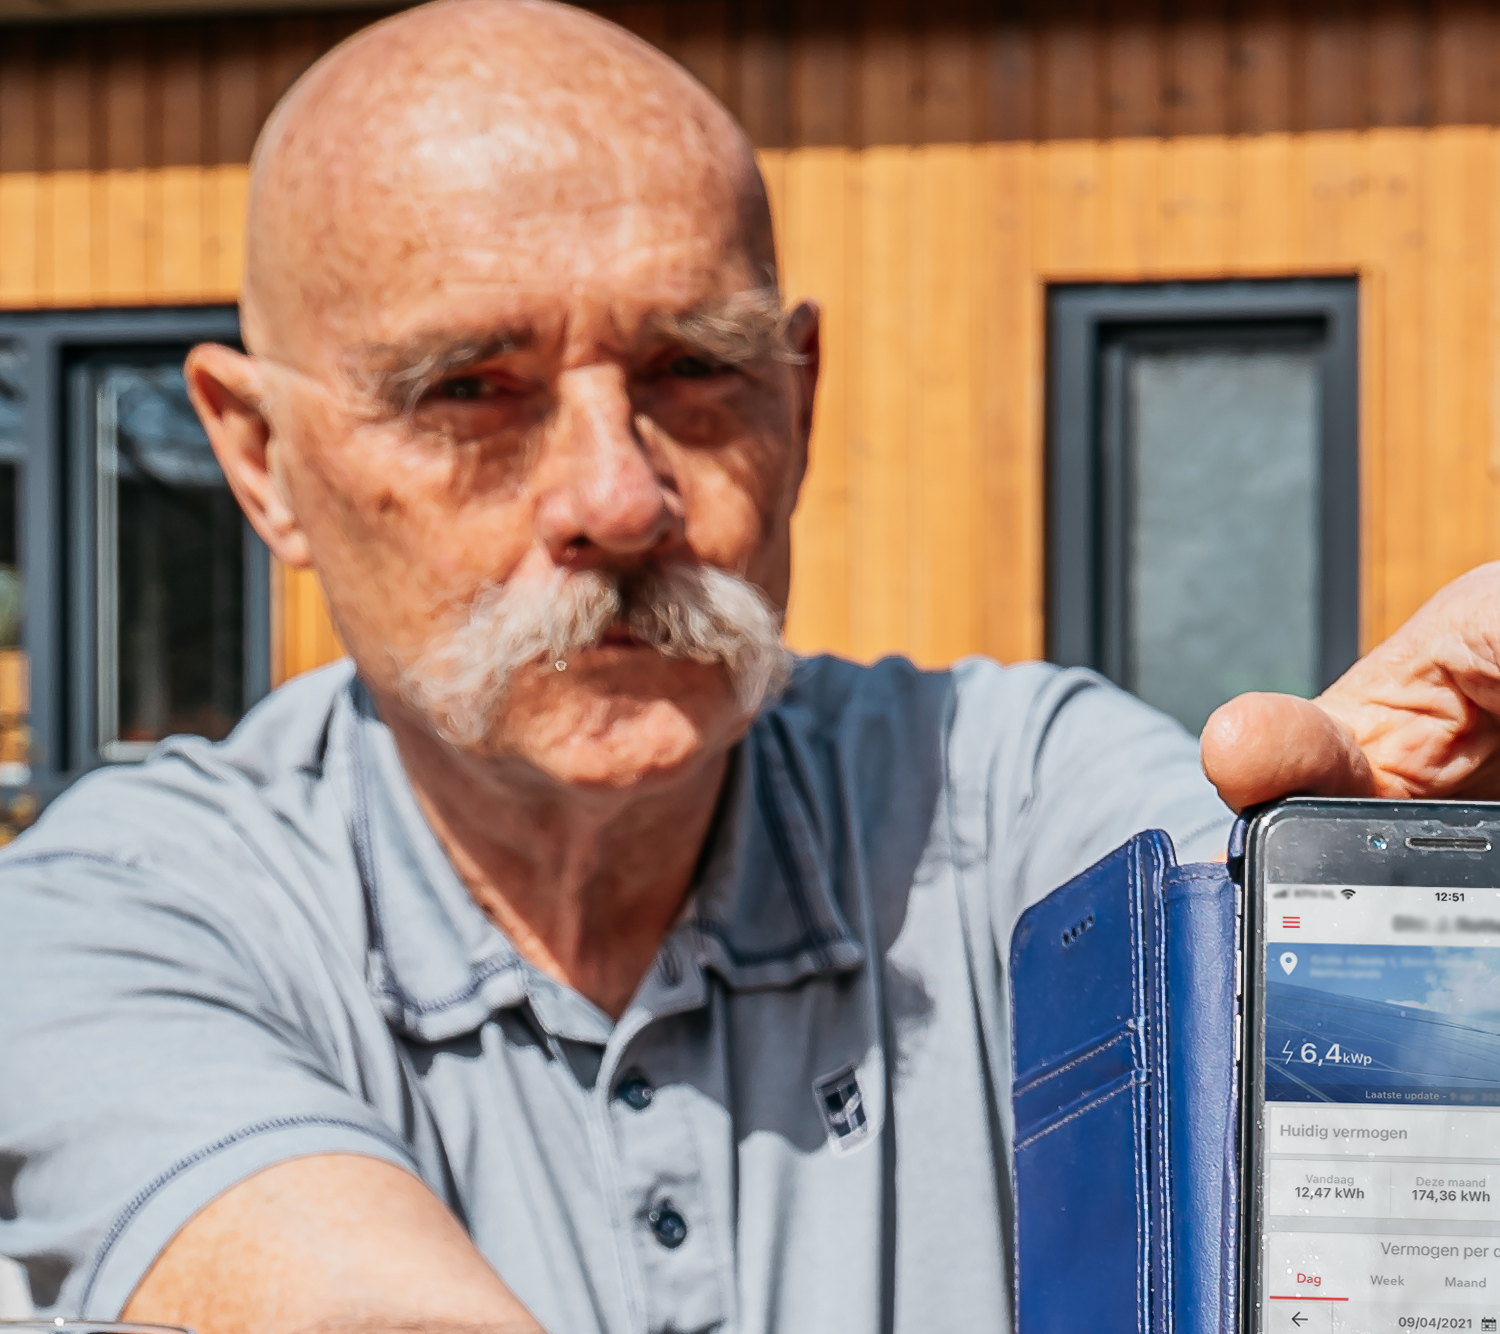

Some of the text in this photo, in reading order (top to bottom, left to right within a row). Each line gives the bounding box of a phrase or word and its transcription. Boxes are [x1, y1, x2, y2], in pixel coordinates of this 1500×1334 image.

[1434, 891, 1465, 903] 12:51
[1365, 1090, 1403, 1100] Laatste
[1404, 1091, 1441, 1102] update
[1280, 1123, 1408, 1142] Huidig vermogen
[1304, 1173, 1355, 1188] Vandaag
[1415, 1176, 1486, 1188] Deze maand
[1294, 1186, 1365, 1200] 12,47 kWh
[1411, 1189, 1491, 1204] 174,36 kWh
[1380, 1241, 1460, 1260] Vermogen
[1463, 1246, 1490, 1260] per
[1296, 1272, 1322, 1287] Dag
[1369, 1274, 1405, 1286] Week
[1444, 1276, 1487, 1289] Maand
[1398, 1316, 1472, 1331] 09/04/2021
